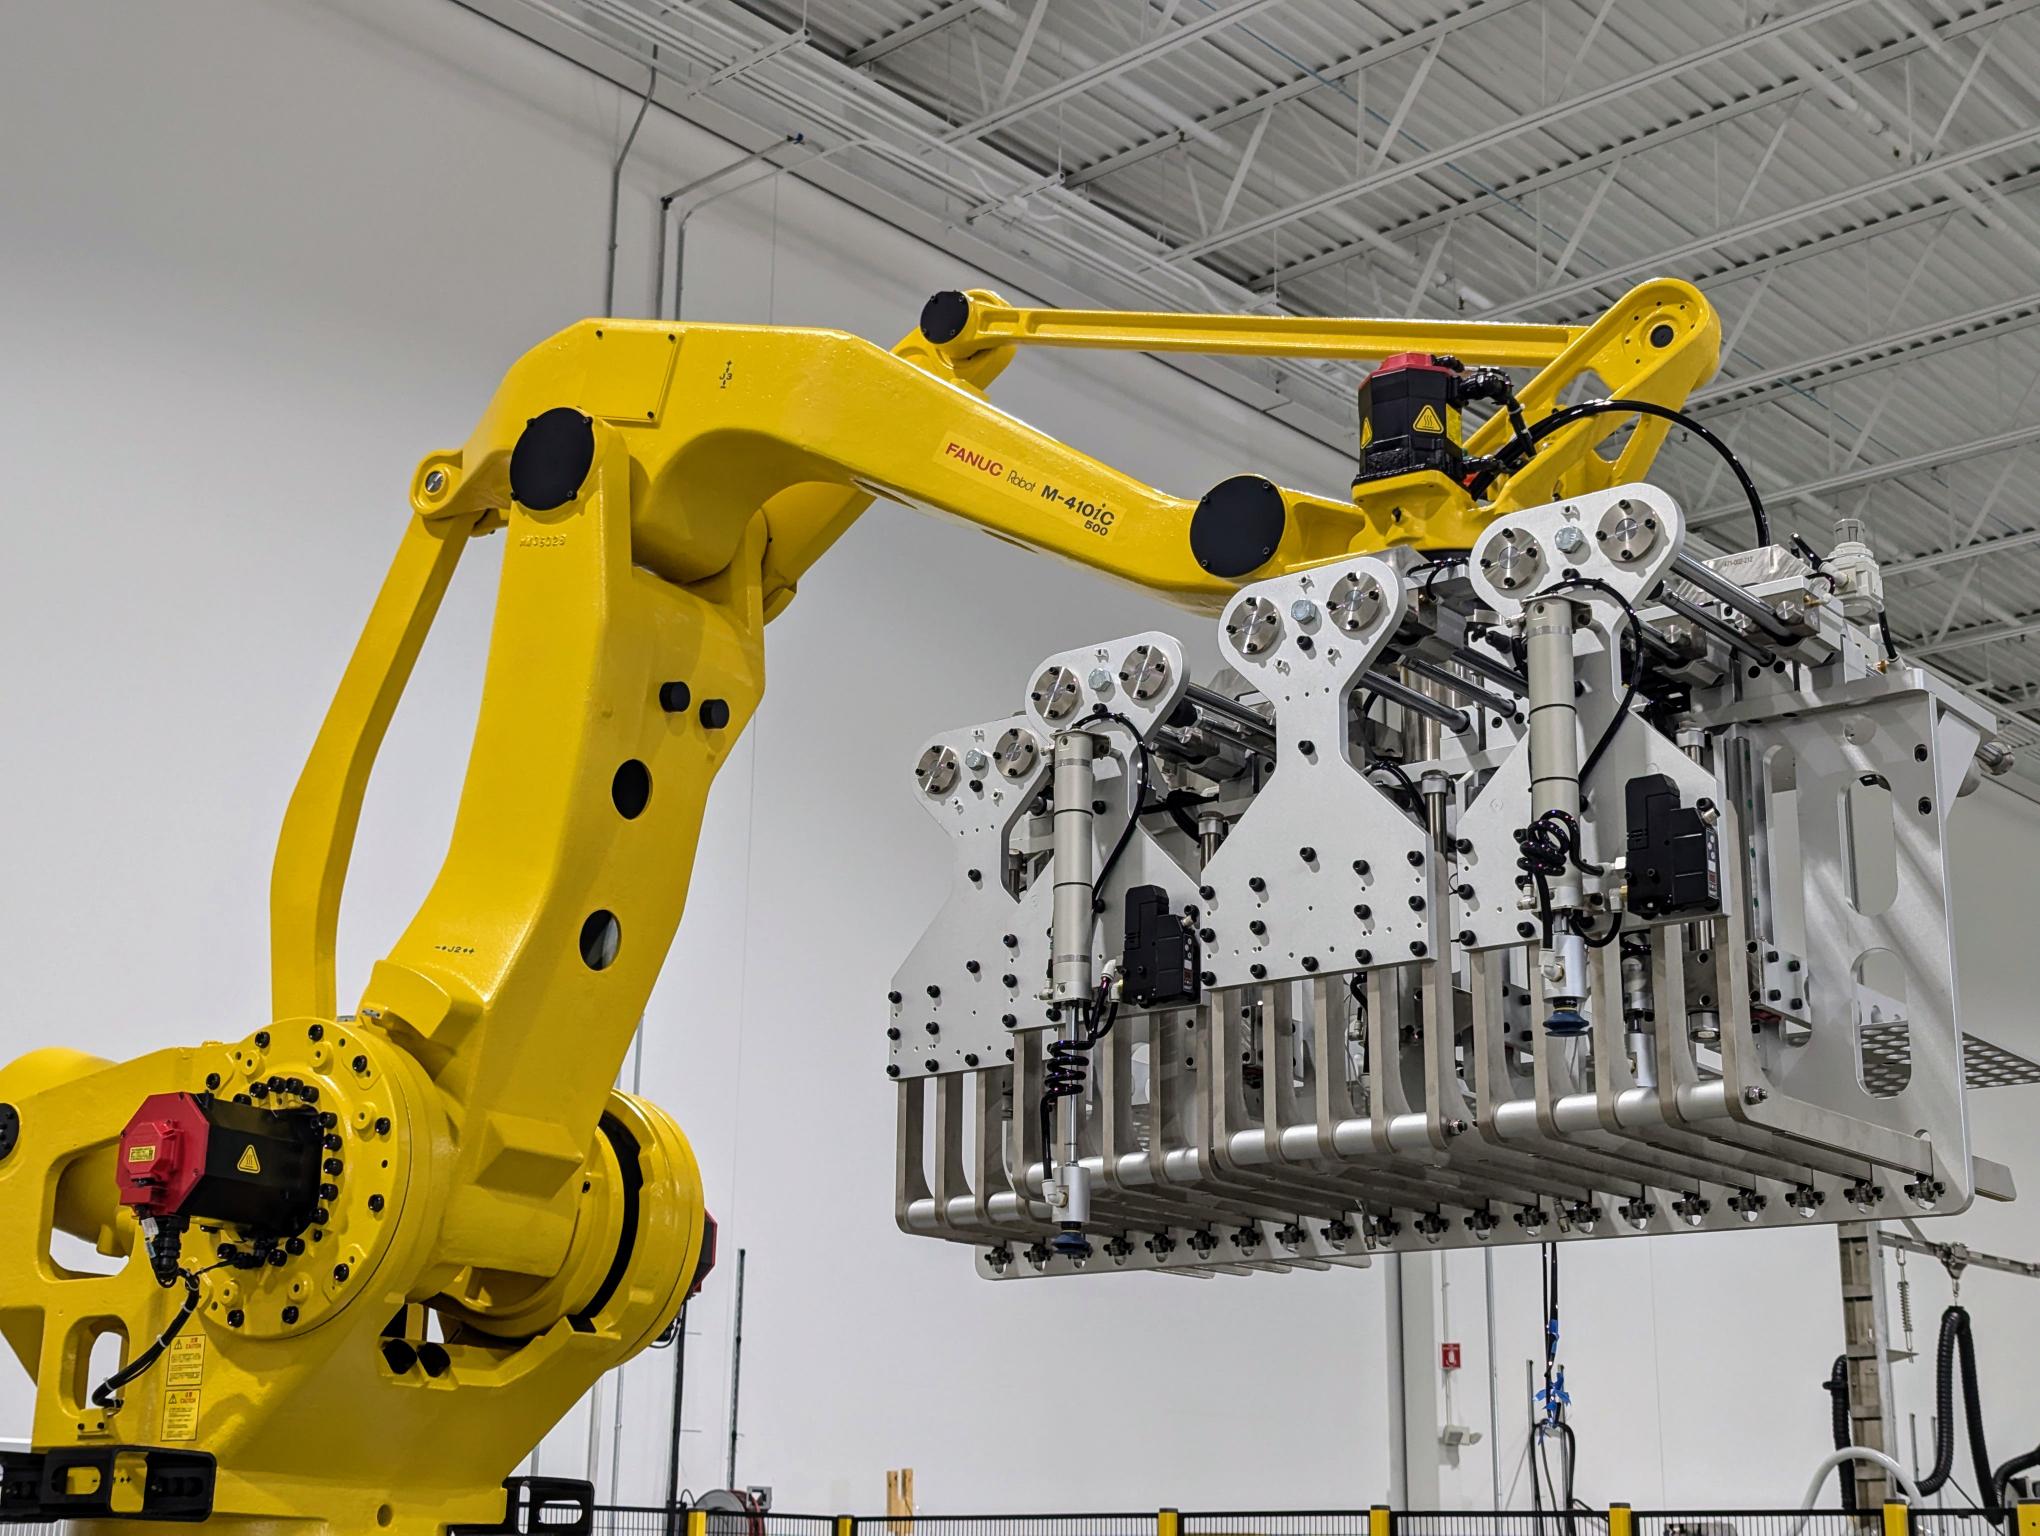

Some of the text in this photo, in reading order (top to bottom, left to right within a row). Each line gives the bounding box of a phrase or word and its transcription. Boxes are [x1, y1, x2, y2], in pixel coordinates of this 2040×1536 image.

[719, 372, 733, 381] J3
[945, 442, 1115, 526] FANUC Robot M-410iC
[1084, 520, 1108, 537] 500
[447, 945, 462, 954] J2
